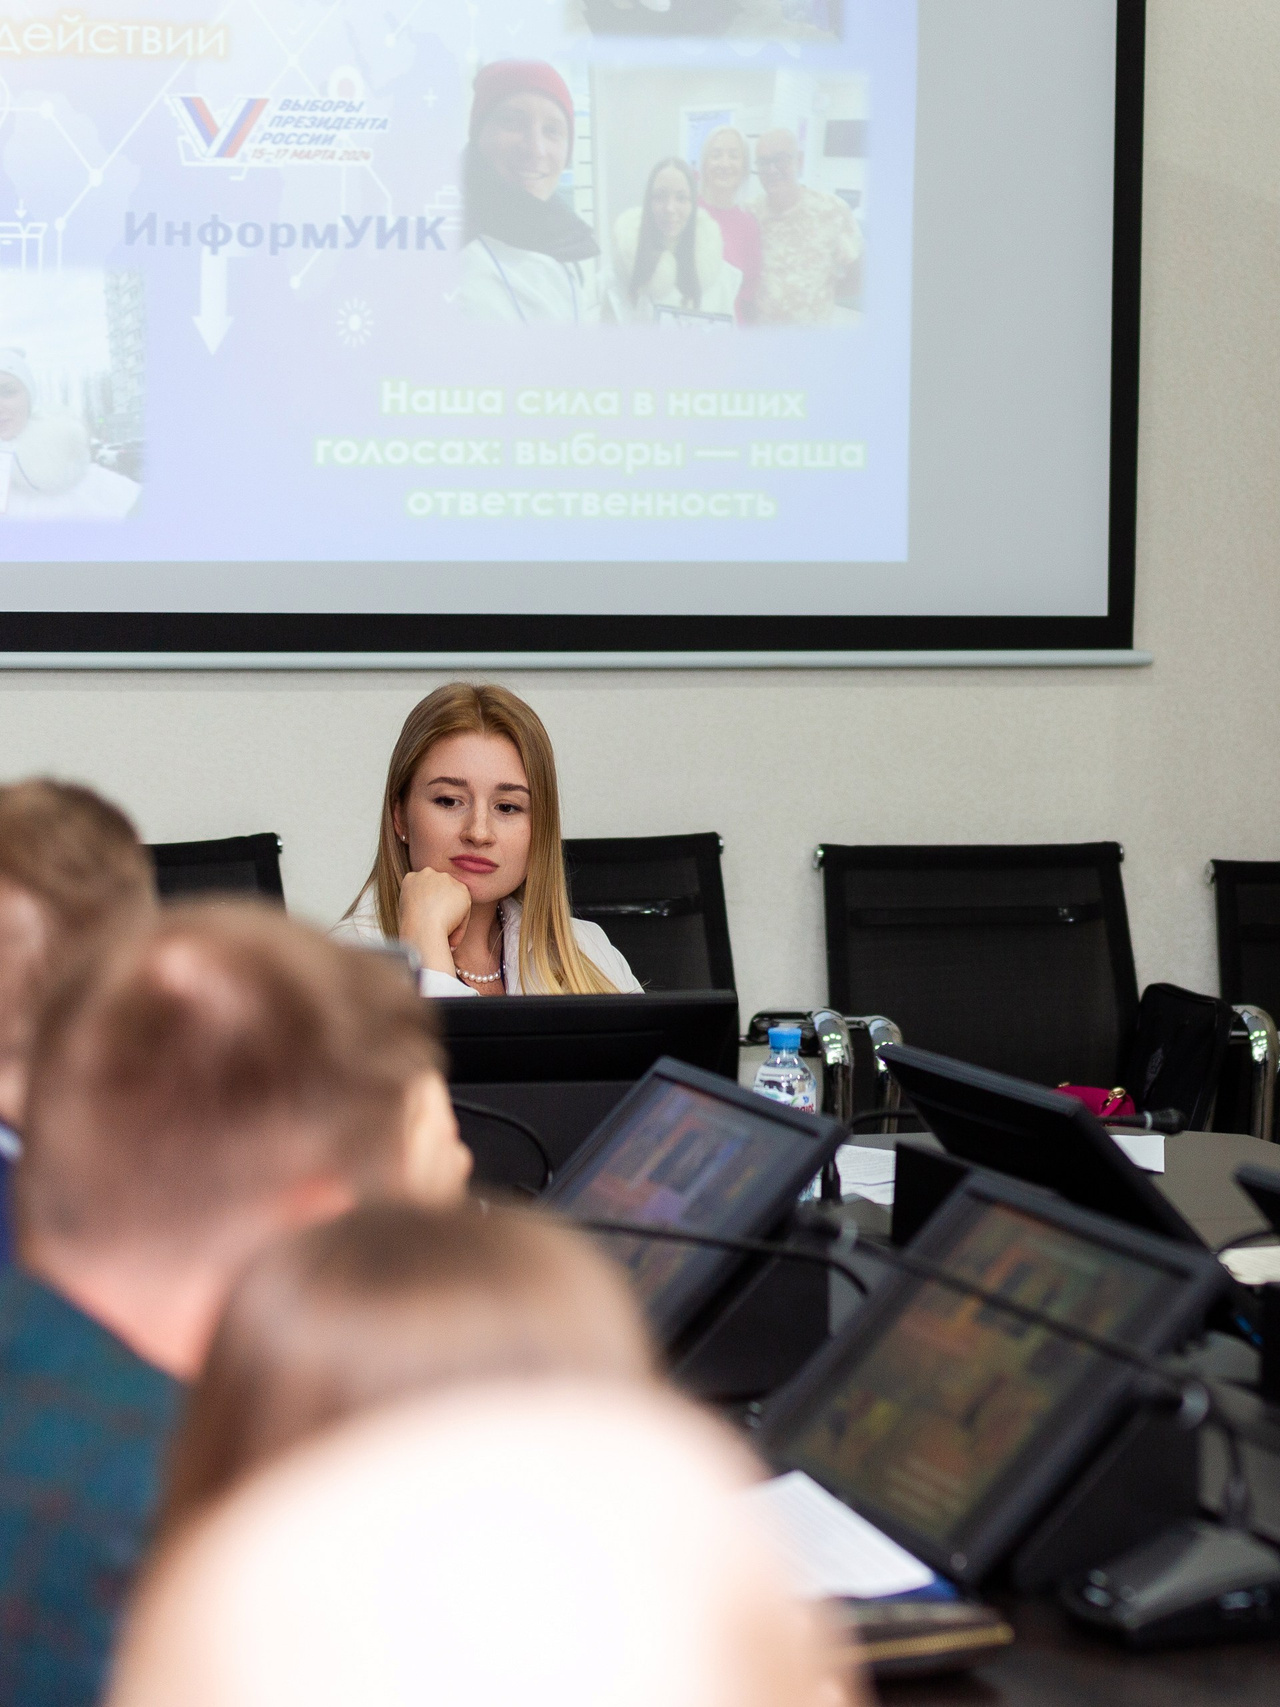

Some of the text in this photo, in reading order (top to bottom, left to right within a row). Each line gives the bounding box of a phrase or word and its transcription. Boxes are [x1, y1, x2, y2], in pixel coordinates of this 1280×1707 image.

[278, 98, 364, 113] ВЫБОРЫ
[268, 115, 388, 131] ПРЕЗИДЕНТА
[258, 132, 336, 146] РОССИИ
[123, 211, 448, 256] ИнформУИК
[380, 381, 806, 418] Наша сила в наших
[315, 437, 501, 466] голосах:
[516, 432, 684, 474] выборы
[750, 441, 866, 468] наша
[408, 489, 778, 518] ответственность
